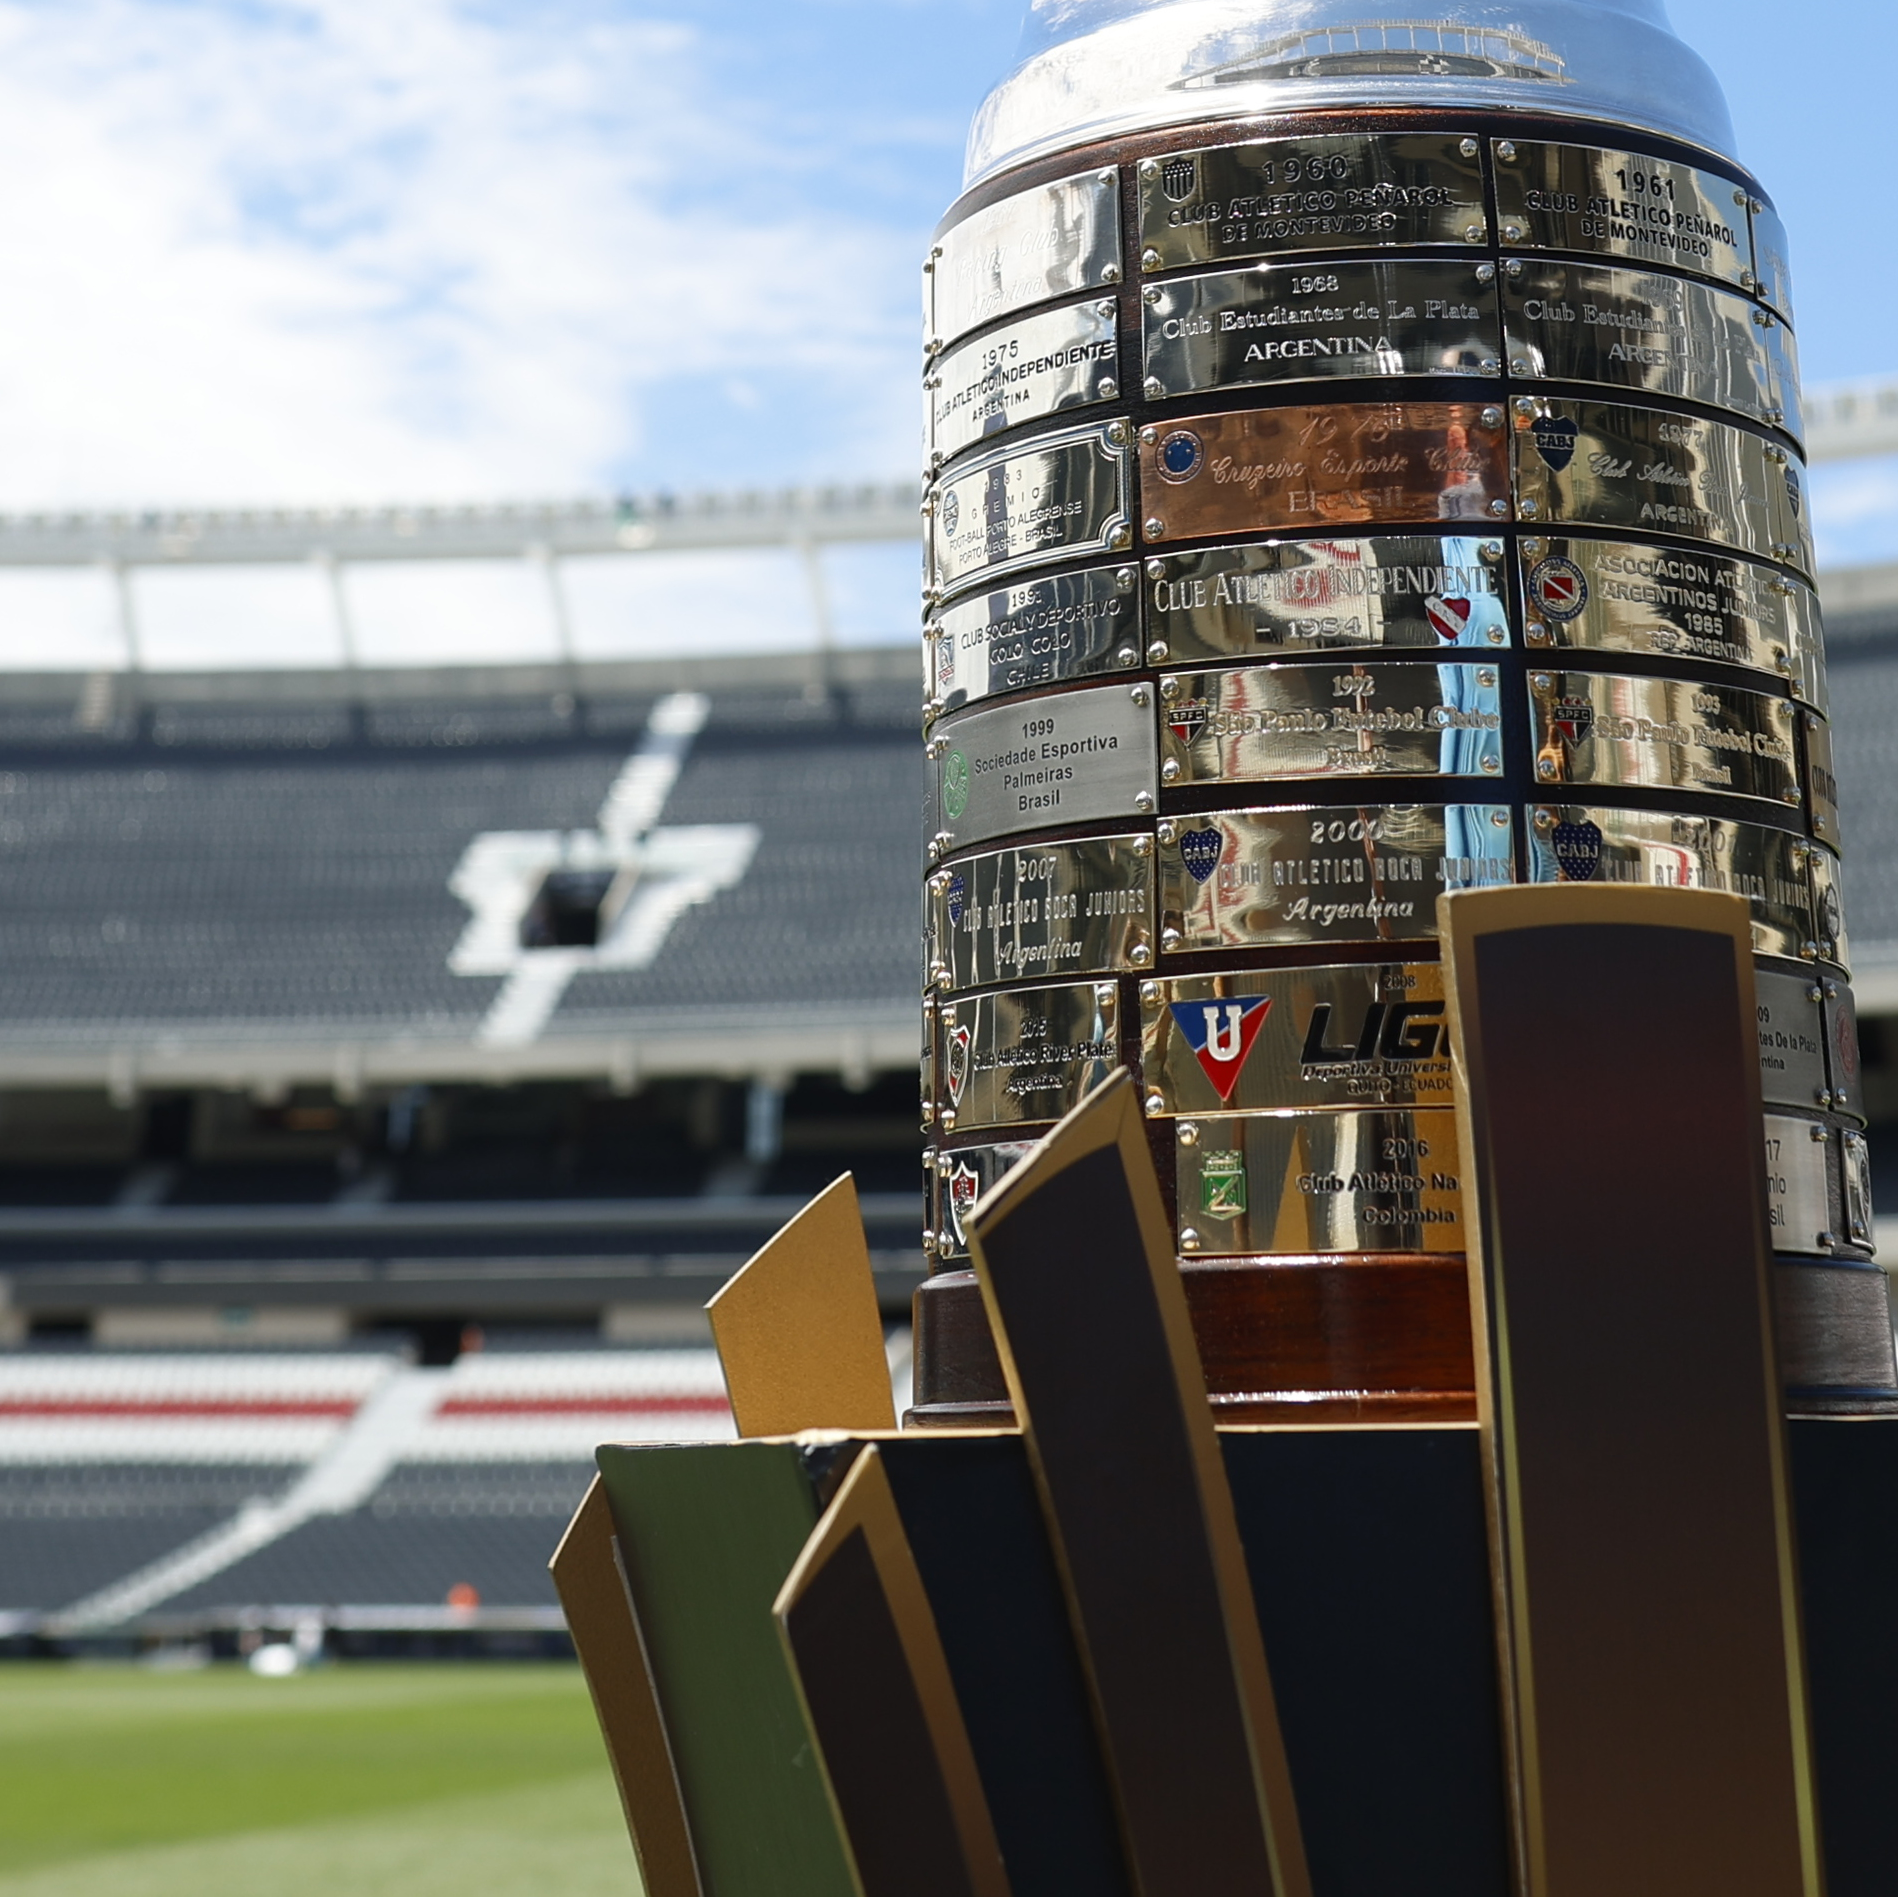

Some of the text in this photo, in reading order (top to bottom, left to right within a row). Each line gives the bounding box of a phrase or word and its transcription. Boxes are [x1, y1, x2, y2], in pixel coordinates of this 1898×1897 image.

[1262, 155, 1348, 184] 1960
[1616, 169, 1676, 201] 1961
[1167, 182, 1453, 228] CLUB ATLETICO PEÑAROL
[1526, 190, 1738, 248] CLUB ATLETICO PEÑAROL
[1020, 227, 1059, 257] Club
[1222, 211, 1396, 244] DE MONTEVIDEO
[1581, 219, 1709, 257] DE MONTEVIDEO
[968, 276, 1042, 322] Argentina
[1291, 275, 1339, 295] 1968
[1162, 299, 1481, 340] Club Estudiantes de La Plata
[1523, 299, 1576, 323] Club
[982, 340, 1019, 370] 1975
[1244, 335, 1394, 363] ARGENTINA
[1608, 342, 1720, 378] ARGENTINA
[936, 341, 1116, 425] CLUB ATLETICO INDEPENDIENTE
[972, 389, 1030, 422] ARGENTINA
[1535, 433, 1576, 449] CABJ
[1658, 422, 1703, 450] 1977
[1210, 456, 1307, 490] Cruzeiro
[986, 514, 1015, 538] PORTO
[1017, 500, 1083, 528] ALEGRENSE
[959, 545, 982, 565] PORTO
[983, 535, 1017, 558] ALEGRE
[1025, 526, 1063, 544] BRASIL
[1595, 554, 1710, 584] ASOCIACION
[1154, 579, 1207, 613] CLUB
[1329, 564, 1499, 596] INDEPENDIENTE
[1601, 581, 1718, 612] ARGENTINOS
[1721, 596, 1776, 625] JUNIORS
[961, 628, 984, 650] CLUB
[1037, 598, 1121, 629] DEPORTIVO
[1288, 616, 1362, 639] 1984
[1684, 612, 1724, 636] 1985
[990, 633, 1071, 666] COLO COLO
[1007, 662, 1050, 686] CHILE
[1332, 674, 1376, 697] 1992
[1022, 718, 1055, 739] 1999
[1173, 712, 1204, 723] SPFC
[1257, 709, 1327, 733] Paulo
[1331, 707, 1424, 732] Futebol
[1428, 705, 1499, 732] Clube
[1557, 709, 1590, 721] SPFC
[1635, 717, 1691, 745] Paulo
[1692, 723, 1752, 754] Futebol
[975, 734, 1118, 775] Sociedade Esportiva
[1004, 766, 1073, 791] Palmeiras
[1018, 789, 1061, 812] Brasil
[1310, 819, 1385, 845] 2000
[1183, 842, 1219, 862] CABJ
[1556, 841, 1599, 860] CABJ
[1018, 856, 1057, 883] 2007
[1218, 855, 1513, 888] CLUB ATLETICO BOCA JUNIORS
[963, 889, 1145, 933] CLUB ATLETICO BOCA JUNIORS
[1282, 895, 1415, 928] Argentina
[996, 937, 1082, 972] Argentina
[1383, 974, 1417, 990] 2008
[1203, 1005, 1242, 1062] U
[1300, 1000, 1450, 1064] LIG
[1776, 1032, 1788, 1049] De
[1790, 1033, 1797, 1050] la
[973, 1052, 994, 1071] Club
[1040, 1042, 1074, 1063] River
[1077, 1040, 1115, 1060] Plate
[1005, 1072, 1063, 1095] Argentina
[1302, 1062, 1380, 1082] Deportiva
[1348, 1079, 1391, 1095] QUITO
[1384, 1138, 1430, 1159] 2016
[1297, 1172, 1344, 1194] Club
[1363, 1206, 1456, 1224] Colombia
